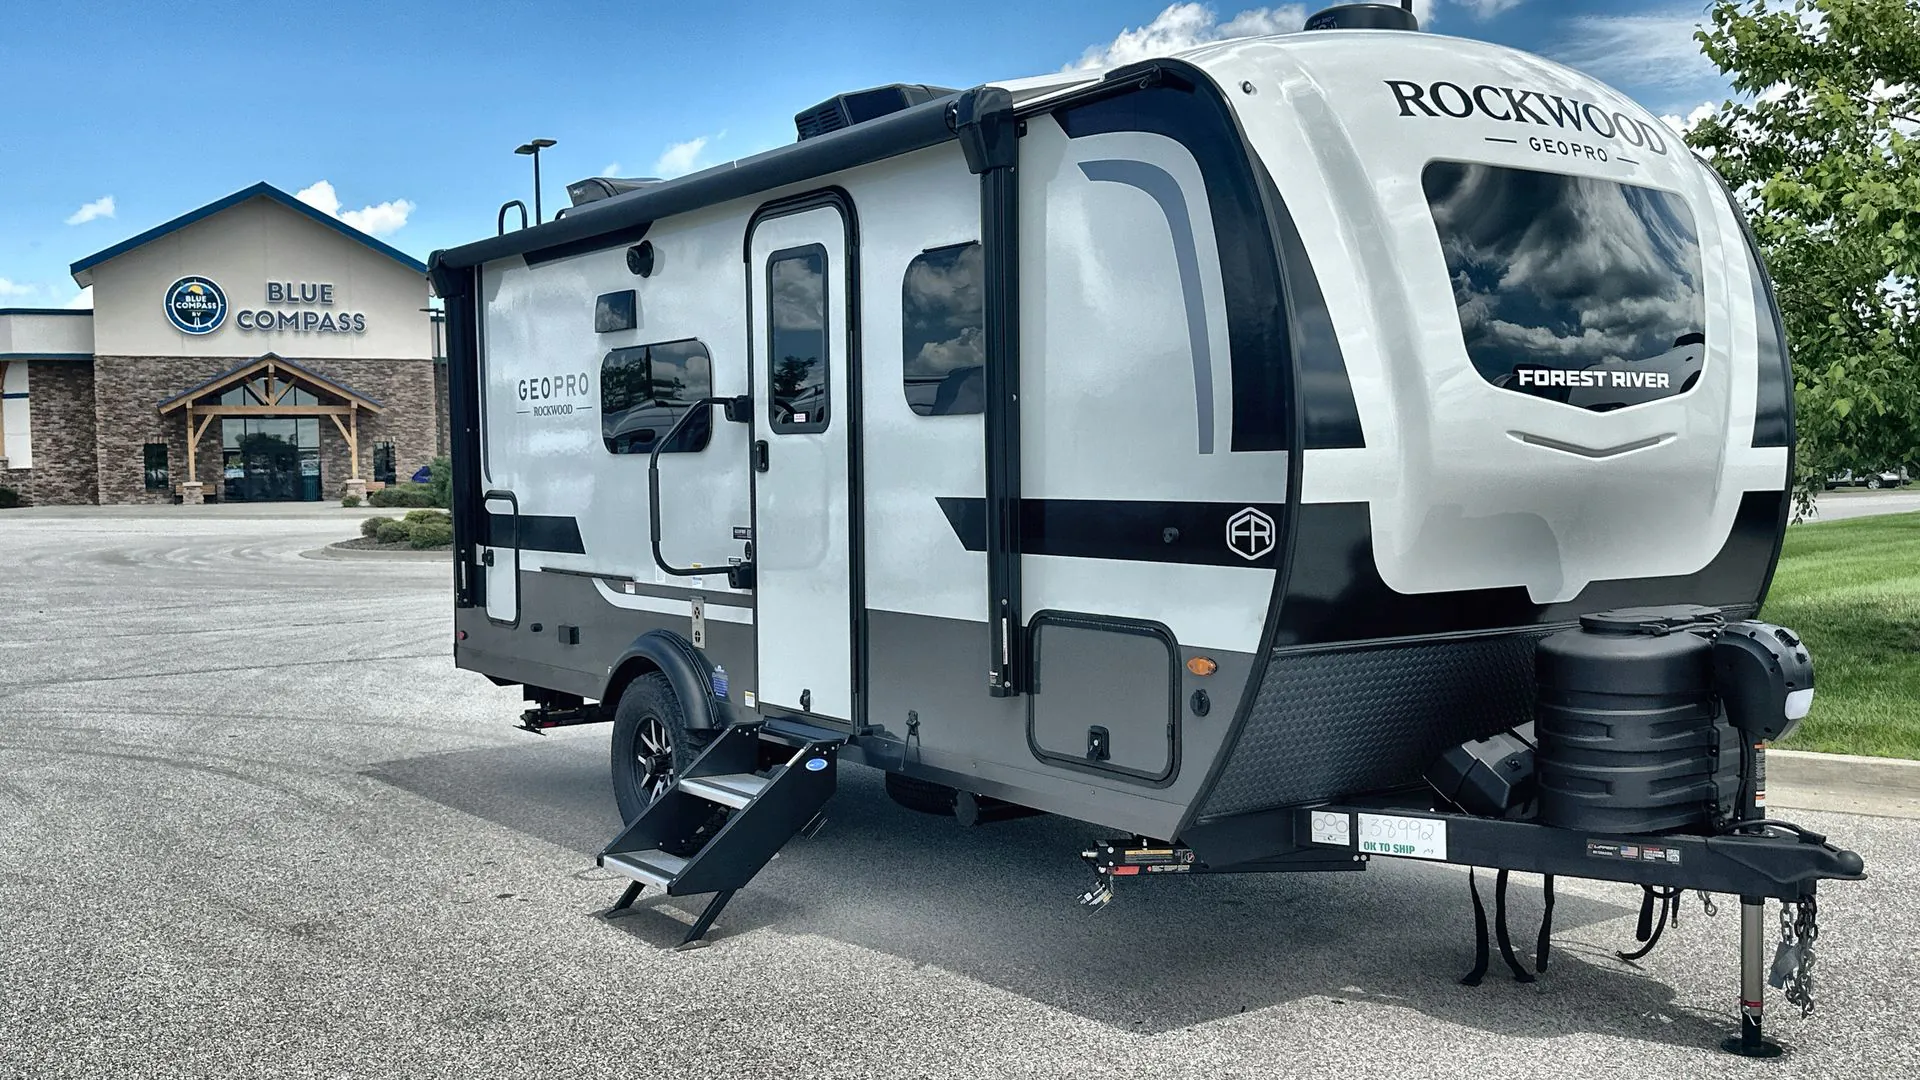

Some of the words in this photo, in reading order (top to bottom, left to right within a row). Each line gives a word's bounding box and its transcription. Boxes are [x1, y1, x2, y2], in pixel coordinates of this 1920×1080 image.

[1383, 80, 1668, 156] ROCKWOOD
[1528, 136, 1608, 162] GEOPRO
[185, 295, 207, 303] BLUE
[267, 281, 334, 304] BLUE
[175, 302, 217, 310] COMPASS
[236, 308, 367, 333] COMPASS
[518, 372, 589, 401] GEOPRO
[1518, 369, 1608, 387] FOREST
[1611, 371, 1670, 388] RIVER
[533, 403, 573, 417] ROCKWOOD
[1363, 841, 1377, 851] OK
[1379, 842, 1391, 852] TO
[1393, 844, 1416, 855] SHIP
